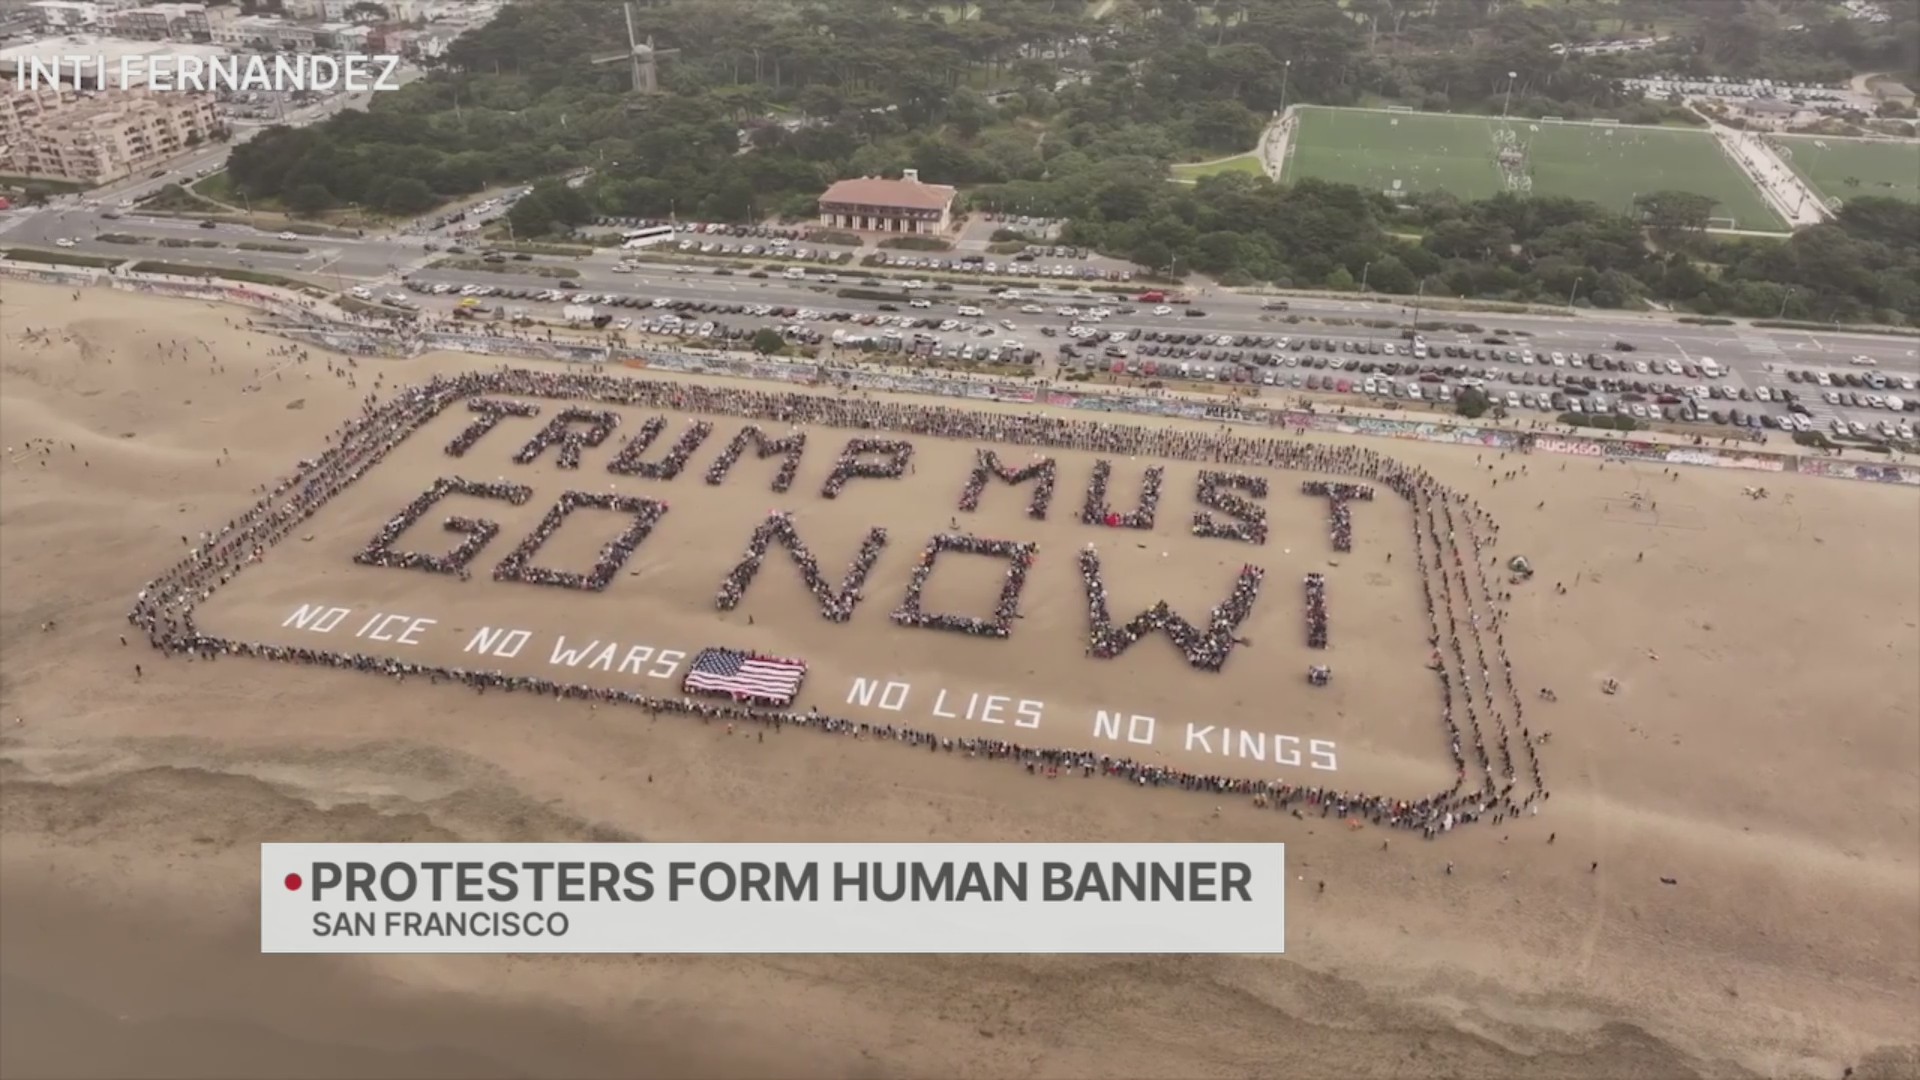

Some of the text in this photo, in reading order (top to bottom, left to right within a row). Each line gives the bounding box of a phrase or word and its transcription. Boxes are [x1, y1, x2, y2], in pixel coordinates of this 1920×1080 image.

[444, 397, 1375, 553] TRUMP MUST
[353, 476, 1331, 686] GO NOW!
[281, 603, 1338, 771] NO ICE NO WARS NO LIES NO KINGS
